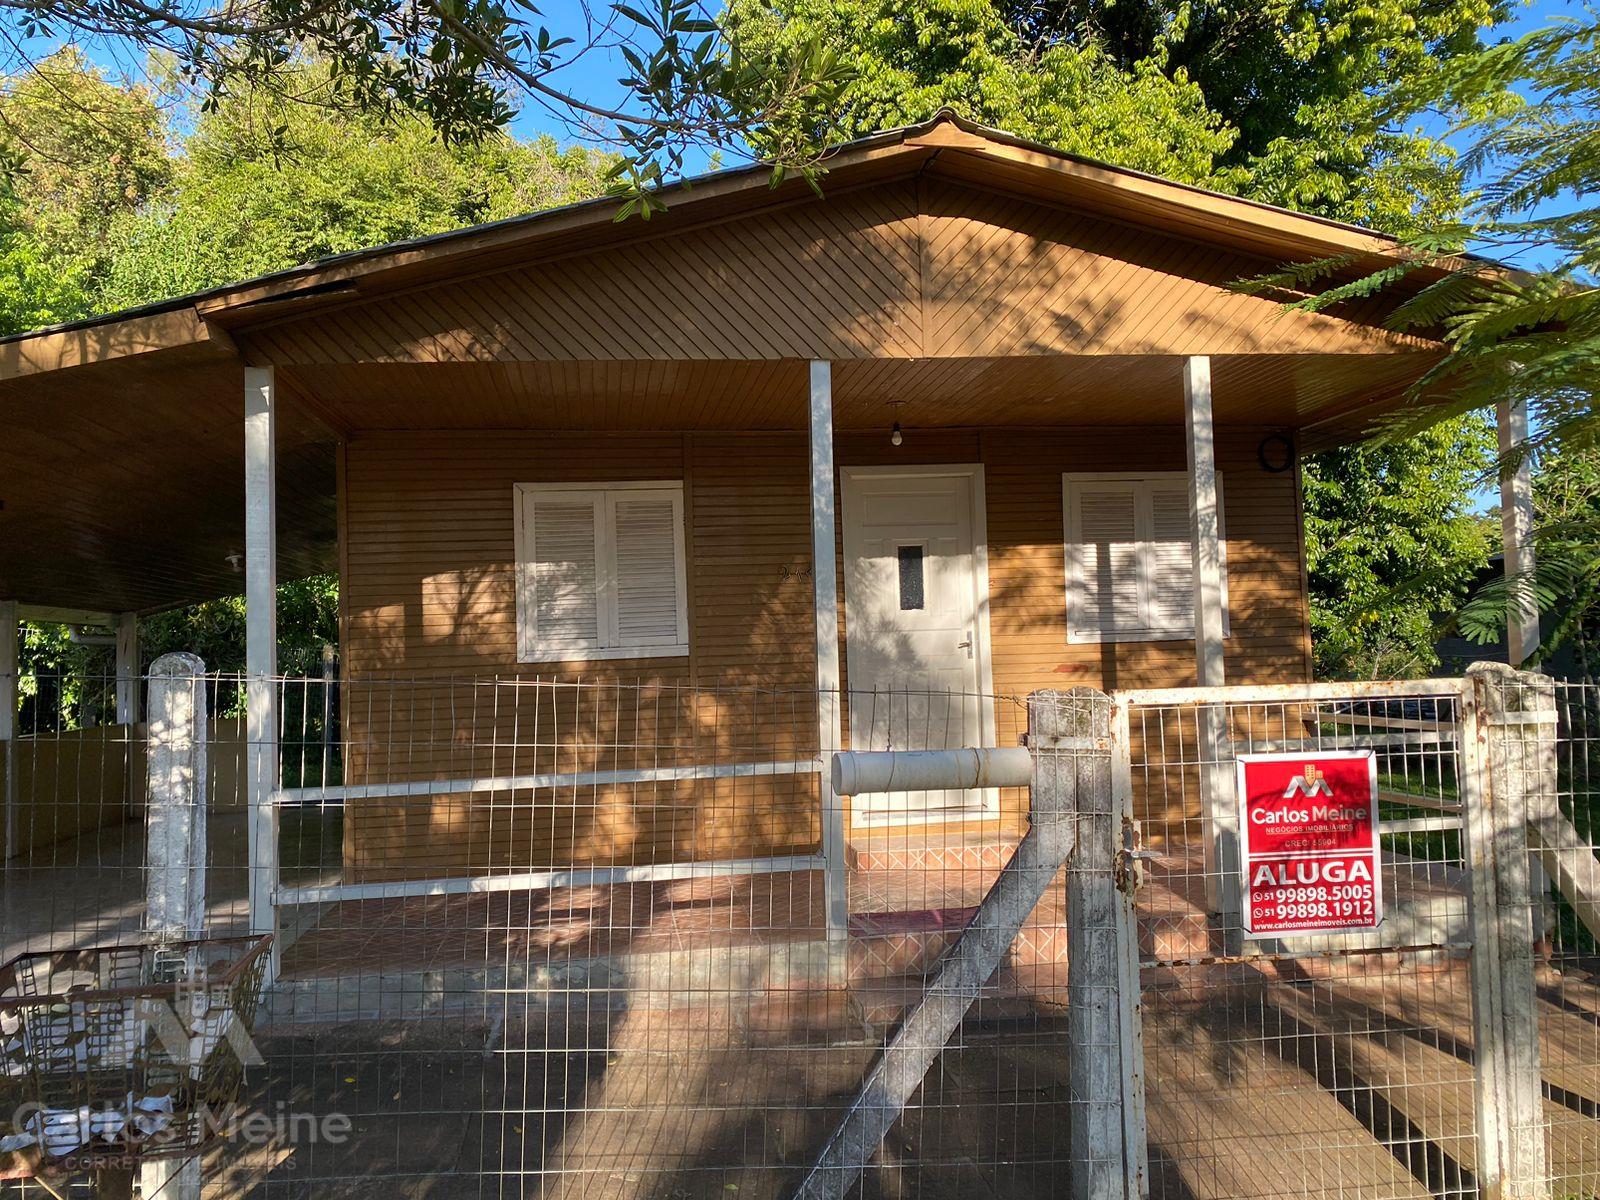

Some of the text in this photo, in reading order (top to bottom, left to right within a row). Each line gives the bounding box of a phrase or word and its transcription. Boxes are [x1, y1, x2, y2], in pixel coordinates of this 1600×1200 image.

[1252, 805, 1366, 824] Carlos Meine
[1252, 860, 1372, 887] ALUGA
[1263, 885, 1372, 903] 51 99898.5005
[1264, 901, 1373, 919] 51 99898.1912
[1254, 918, 1373, 929] www.carlosmeineimoveis.com.br
